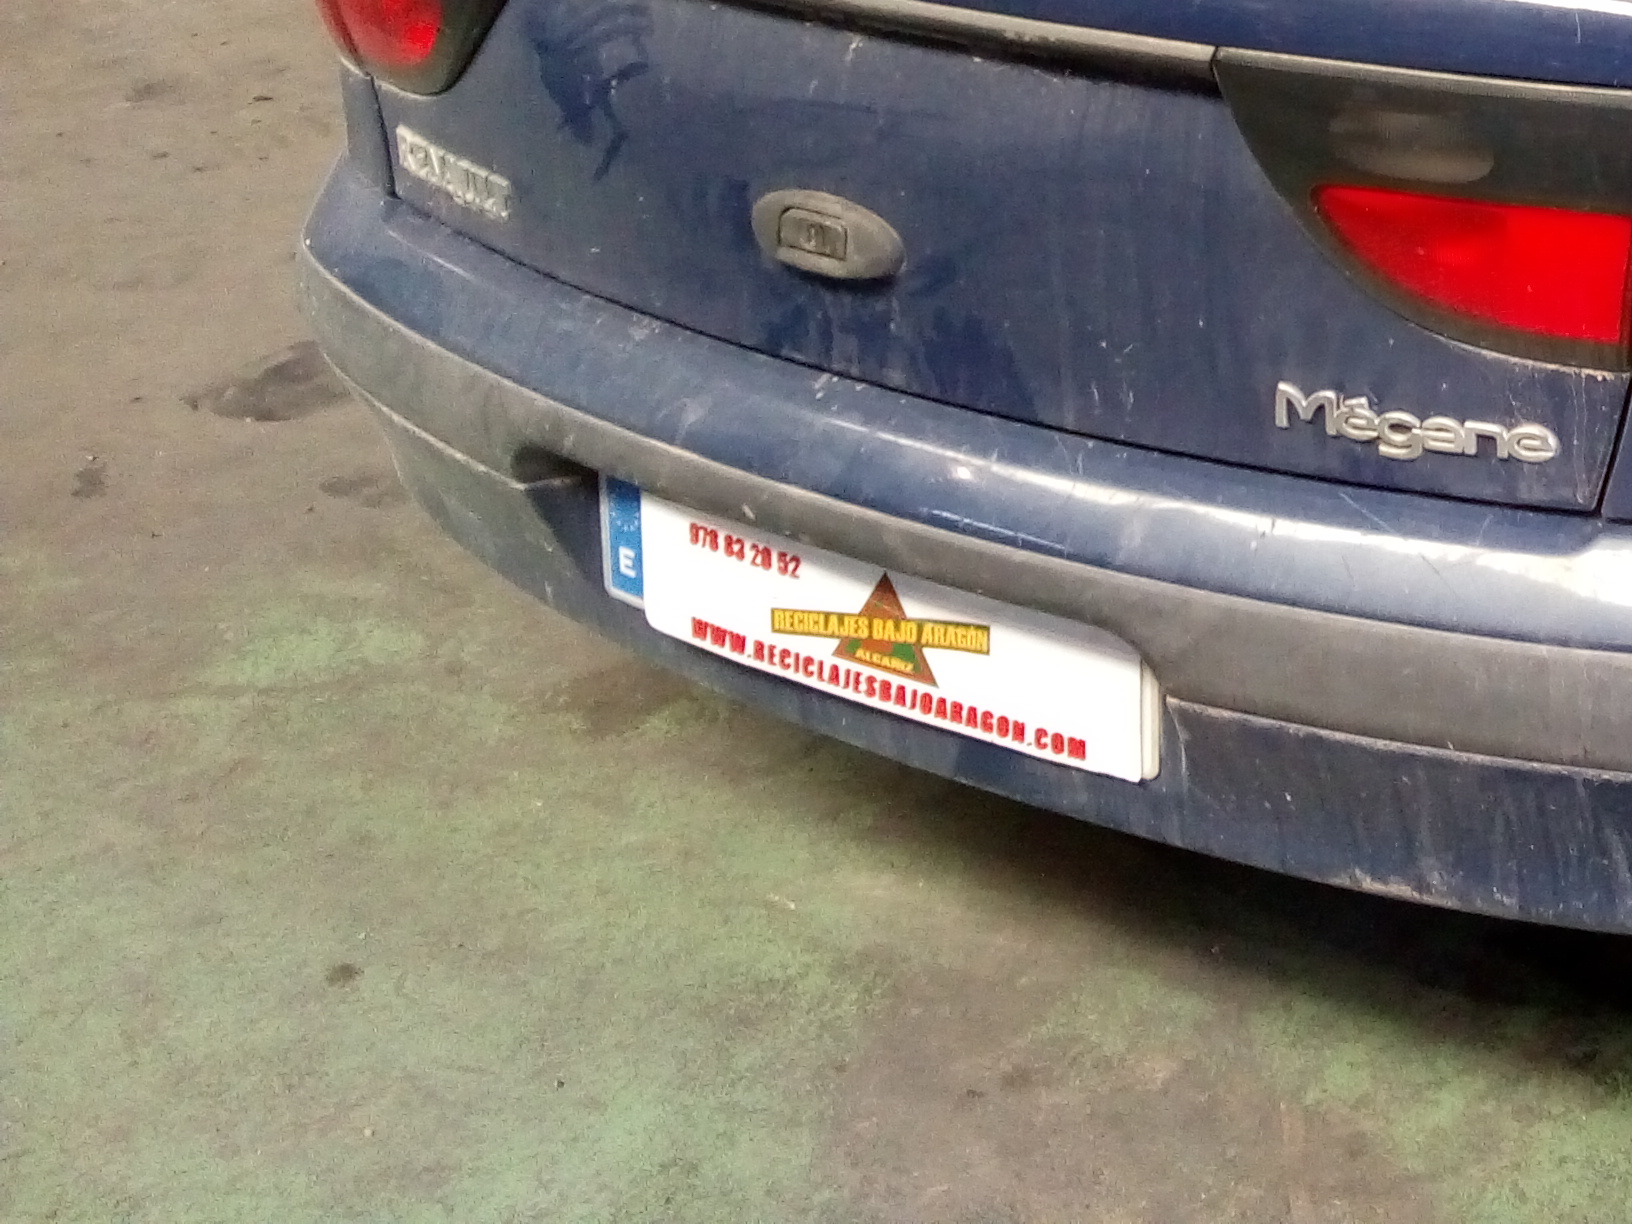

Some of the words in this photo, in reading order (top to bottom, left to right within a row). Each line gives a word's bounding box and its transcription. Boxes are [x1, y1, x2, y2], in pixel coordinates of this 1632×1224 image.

[618, 546, 637, 579] E
[777, 550, 801, 580] 52
[773, 609, 870, 640] RECICLAJES
[871, 617, 918, 644] BAJO
[691, 616, 1088, 761] WWW.RECICLAJESBAJOARAGON.COM
